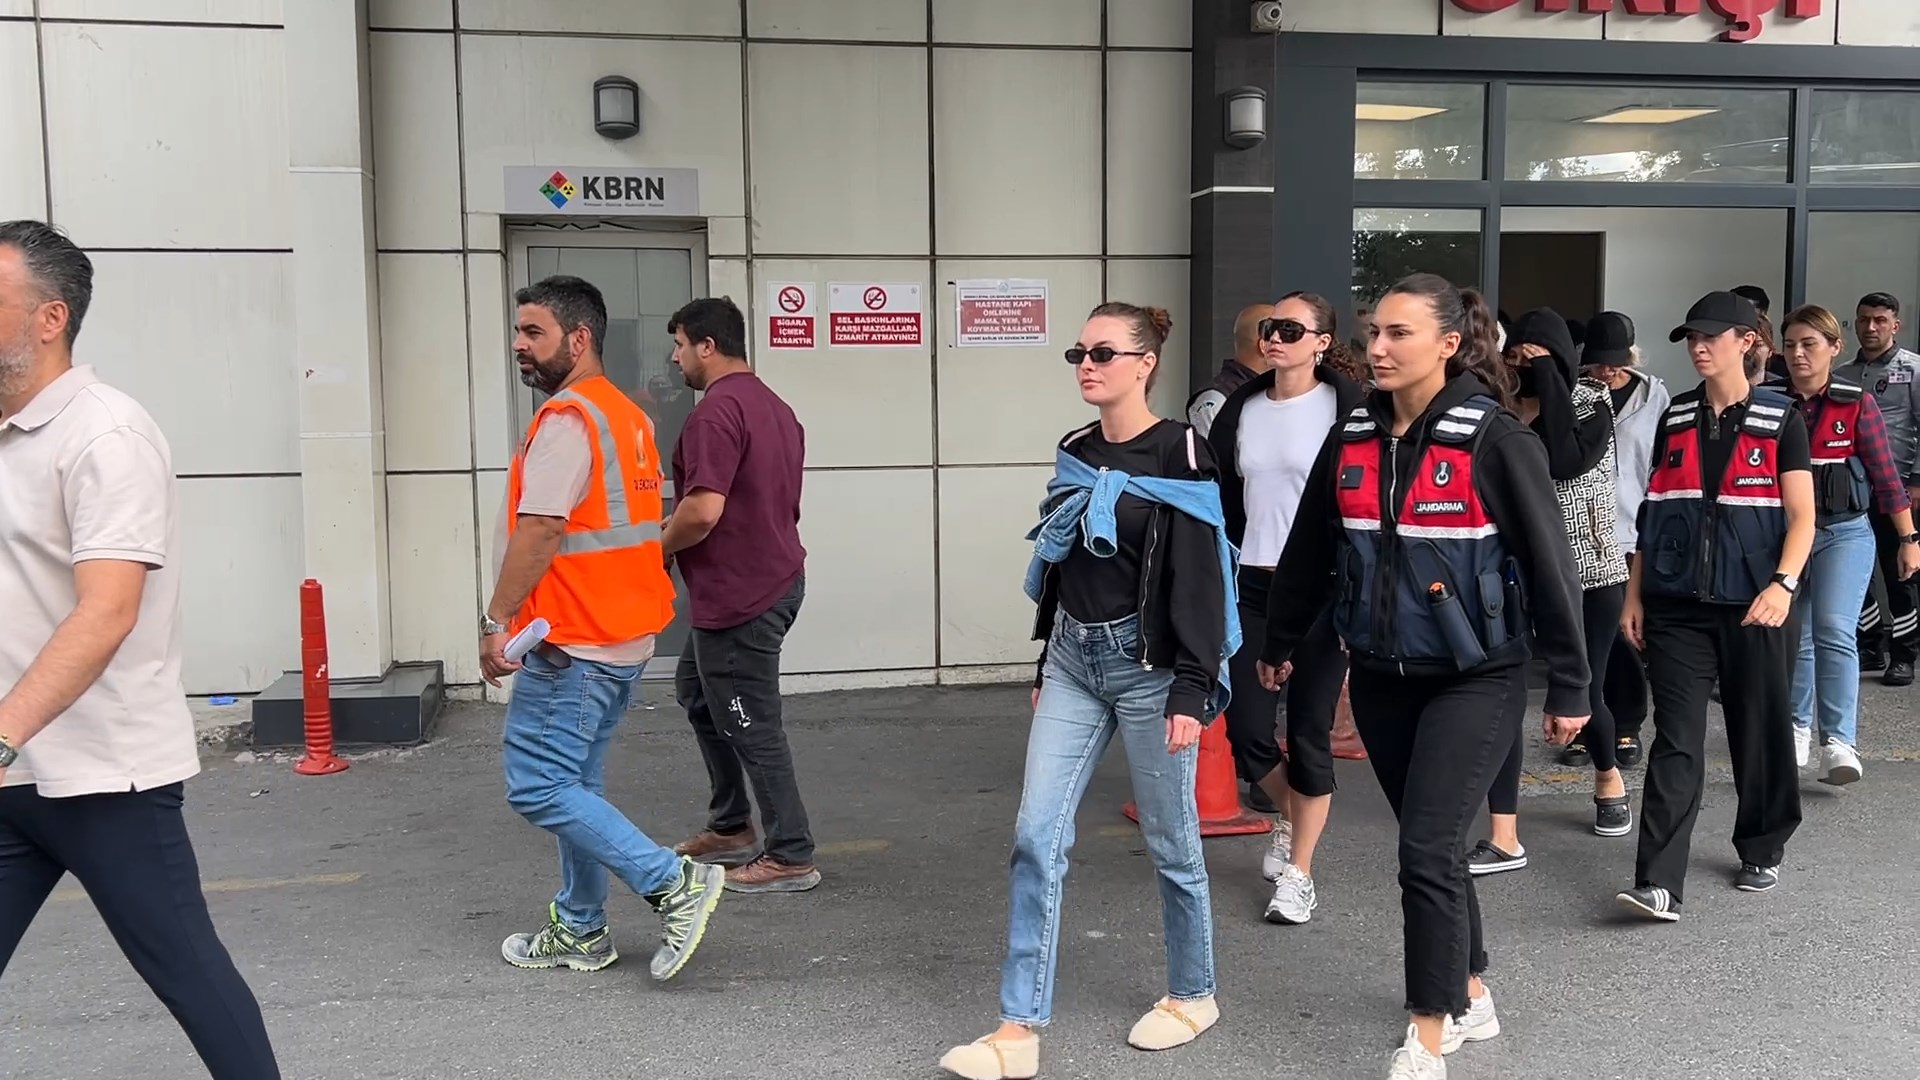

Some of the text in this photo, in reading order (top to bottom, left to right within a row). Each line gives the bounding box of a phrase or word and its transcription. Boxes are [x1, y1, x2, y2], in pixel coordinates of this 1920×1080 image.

[582, 176, 664, 200] KBRN
[777, 318, 807, 327] SİGARA
[837, 316, 916, 324] SEL BASKINLARINA
[779, 327, 805, 336] İÇMEK
[835, 325, 860, 333] KARŞI
[773, 337, 812, 345] YASAKTIR
[835, 333, 870, 341] İZMARİT
[1737, 477, 1773, 485] JANDARMA
[1416, 501, 1464, 512] JANDARMA
